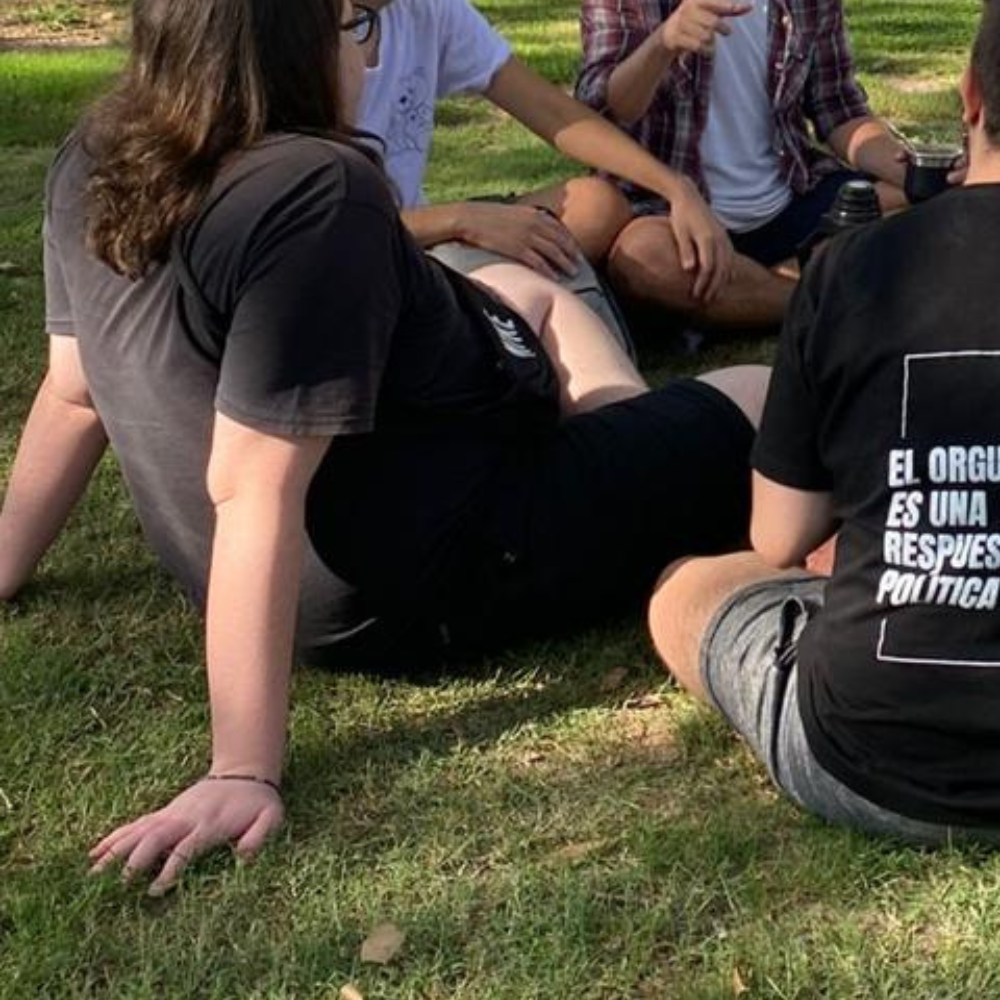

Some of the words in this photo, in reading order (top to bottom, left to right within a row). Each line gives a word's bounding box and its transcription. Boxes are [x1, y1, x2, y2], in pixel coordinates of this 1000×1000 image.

[888, 449, 920, 487] EL
[885, 491, 924, 528] ES
[929, 490, 988, 527] UNA
